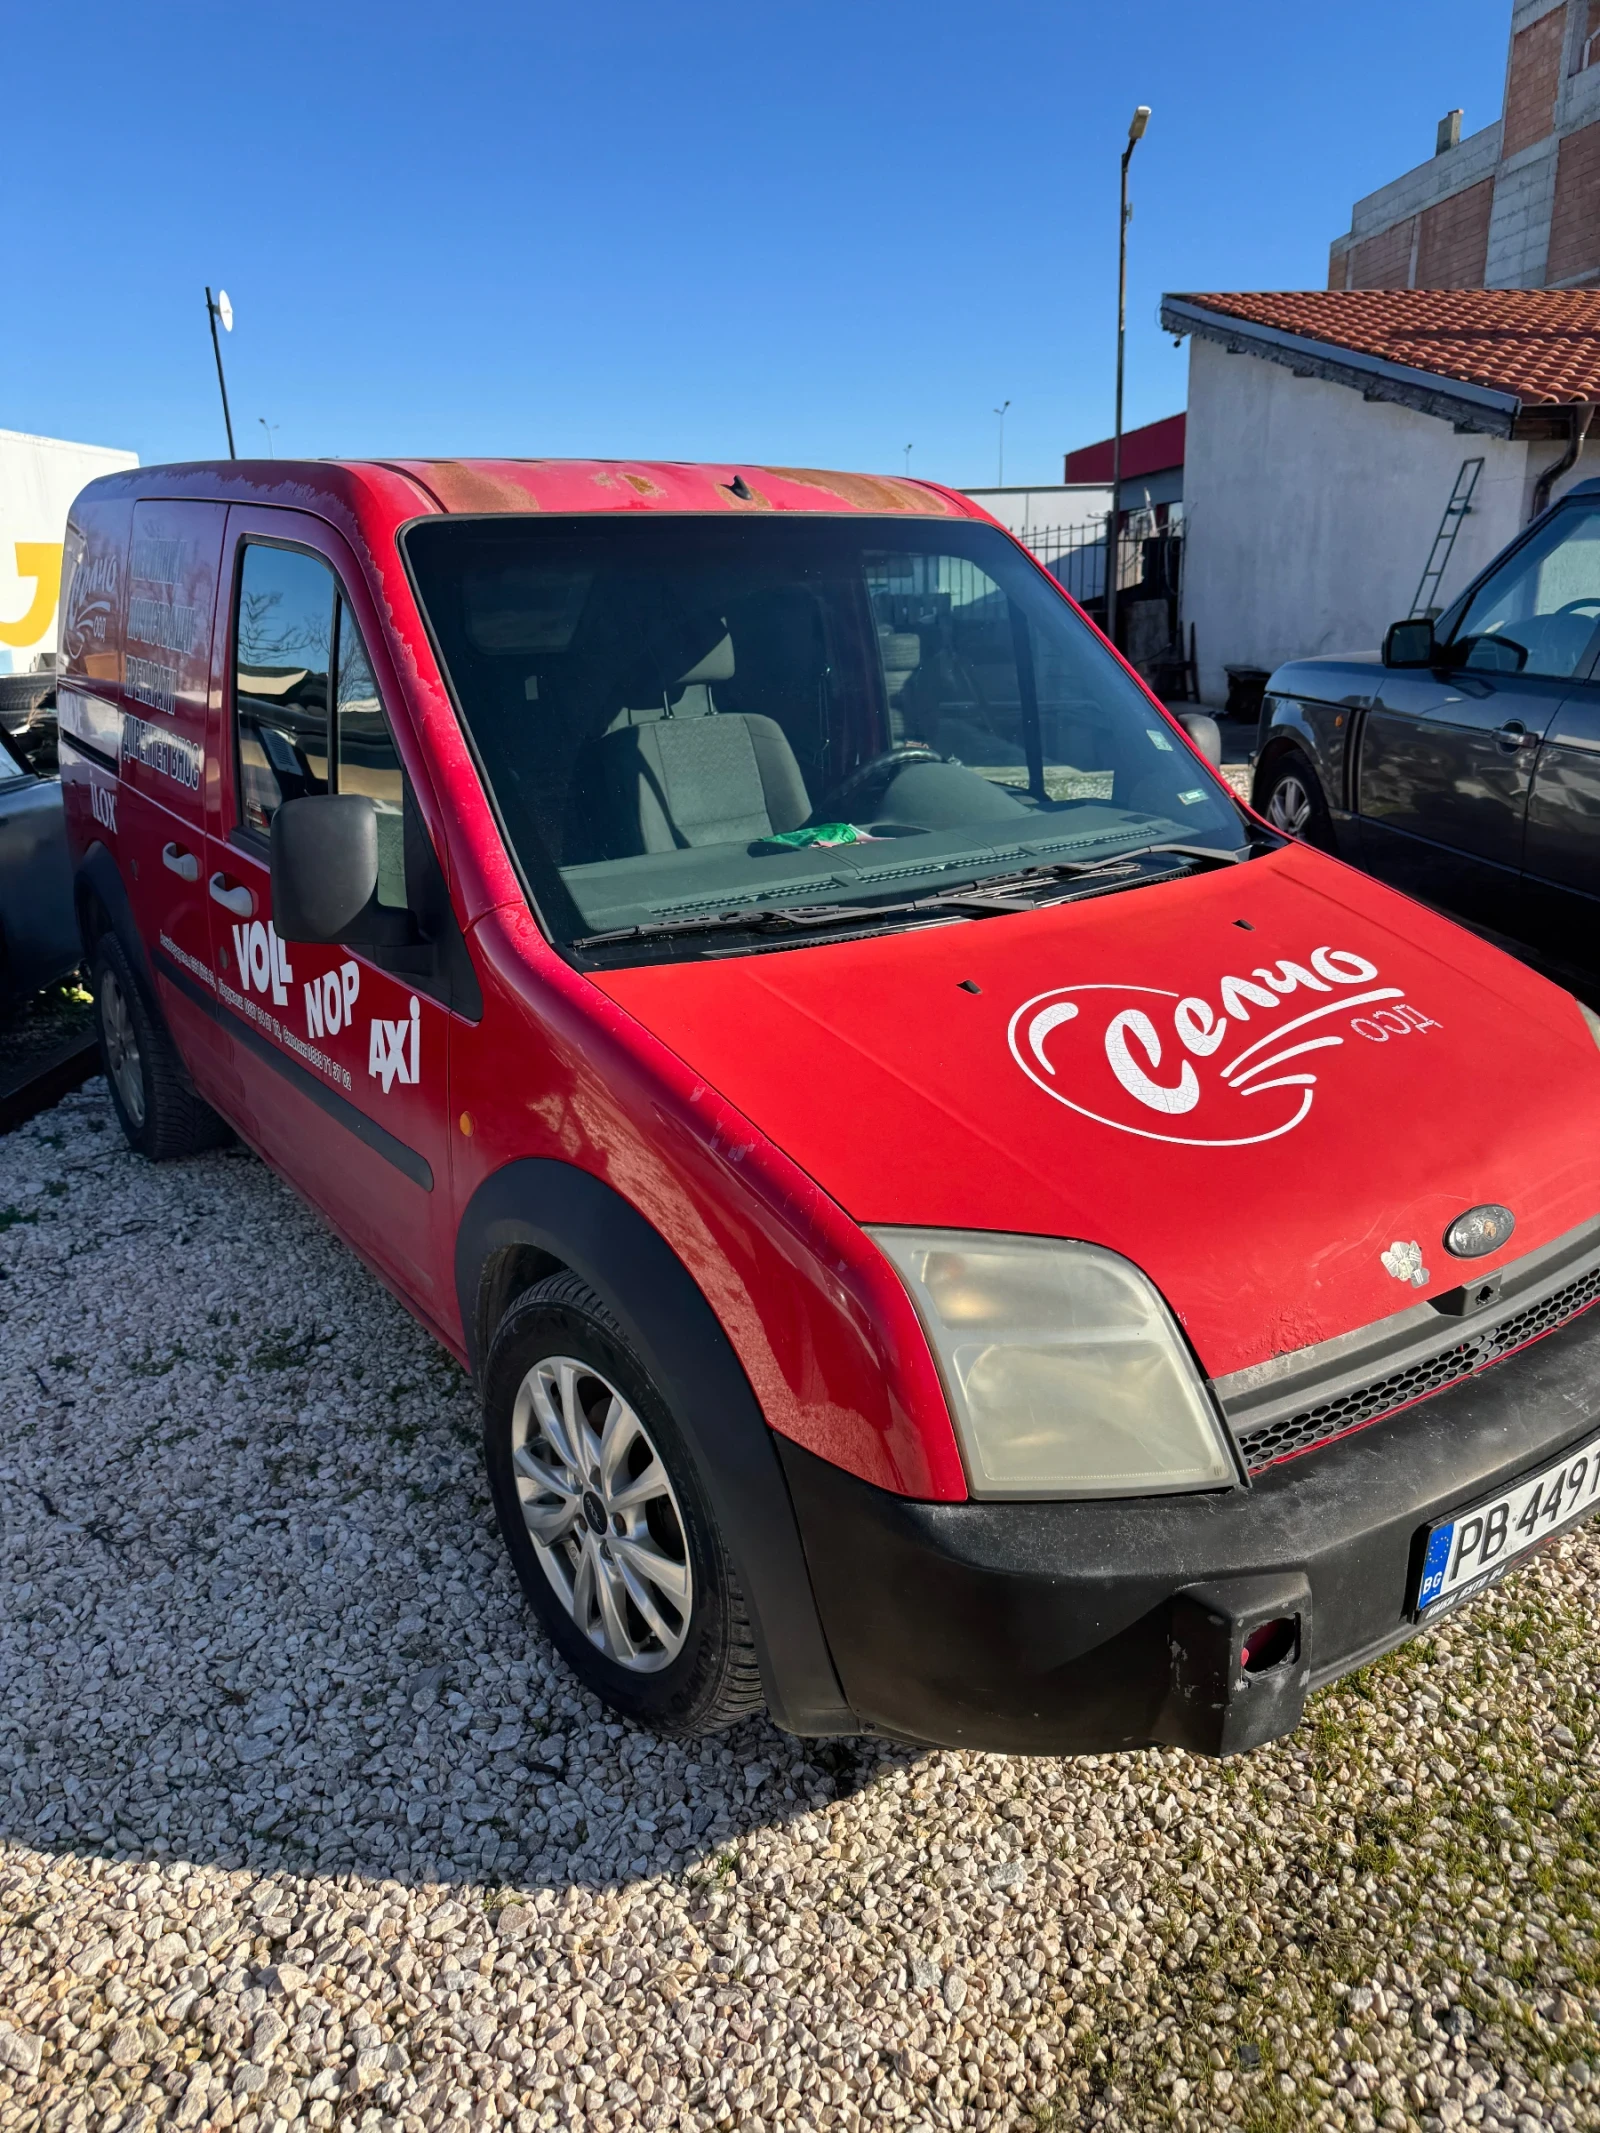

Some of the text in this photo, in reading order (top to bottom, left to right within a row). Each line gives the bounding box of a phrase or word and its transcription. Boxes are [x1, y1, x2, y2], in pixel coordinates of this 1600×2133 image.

[124, 654, 177, 716] ПРЕПАРАТИ
[170, 734, 200, 791] ВНОС
[1449, 1502, 1510, 1582] PB
[1423, 1571, 1443, 1595] BG
